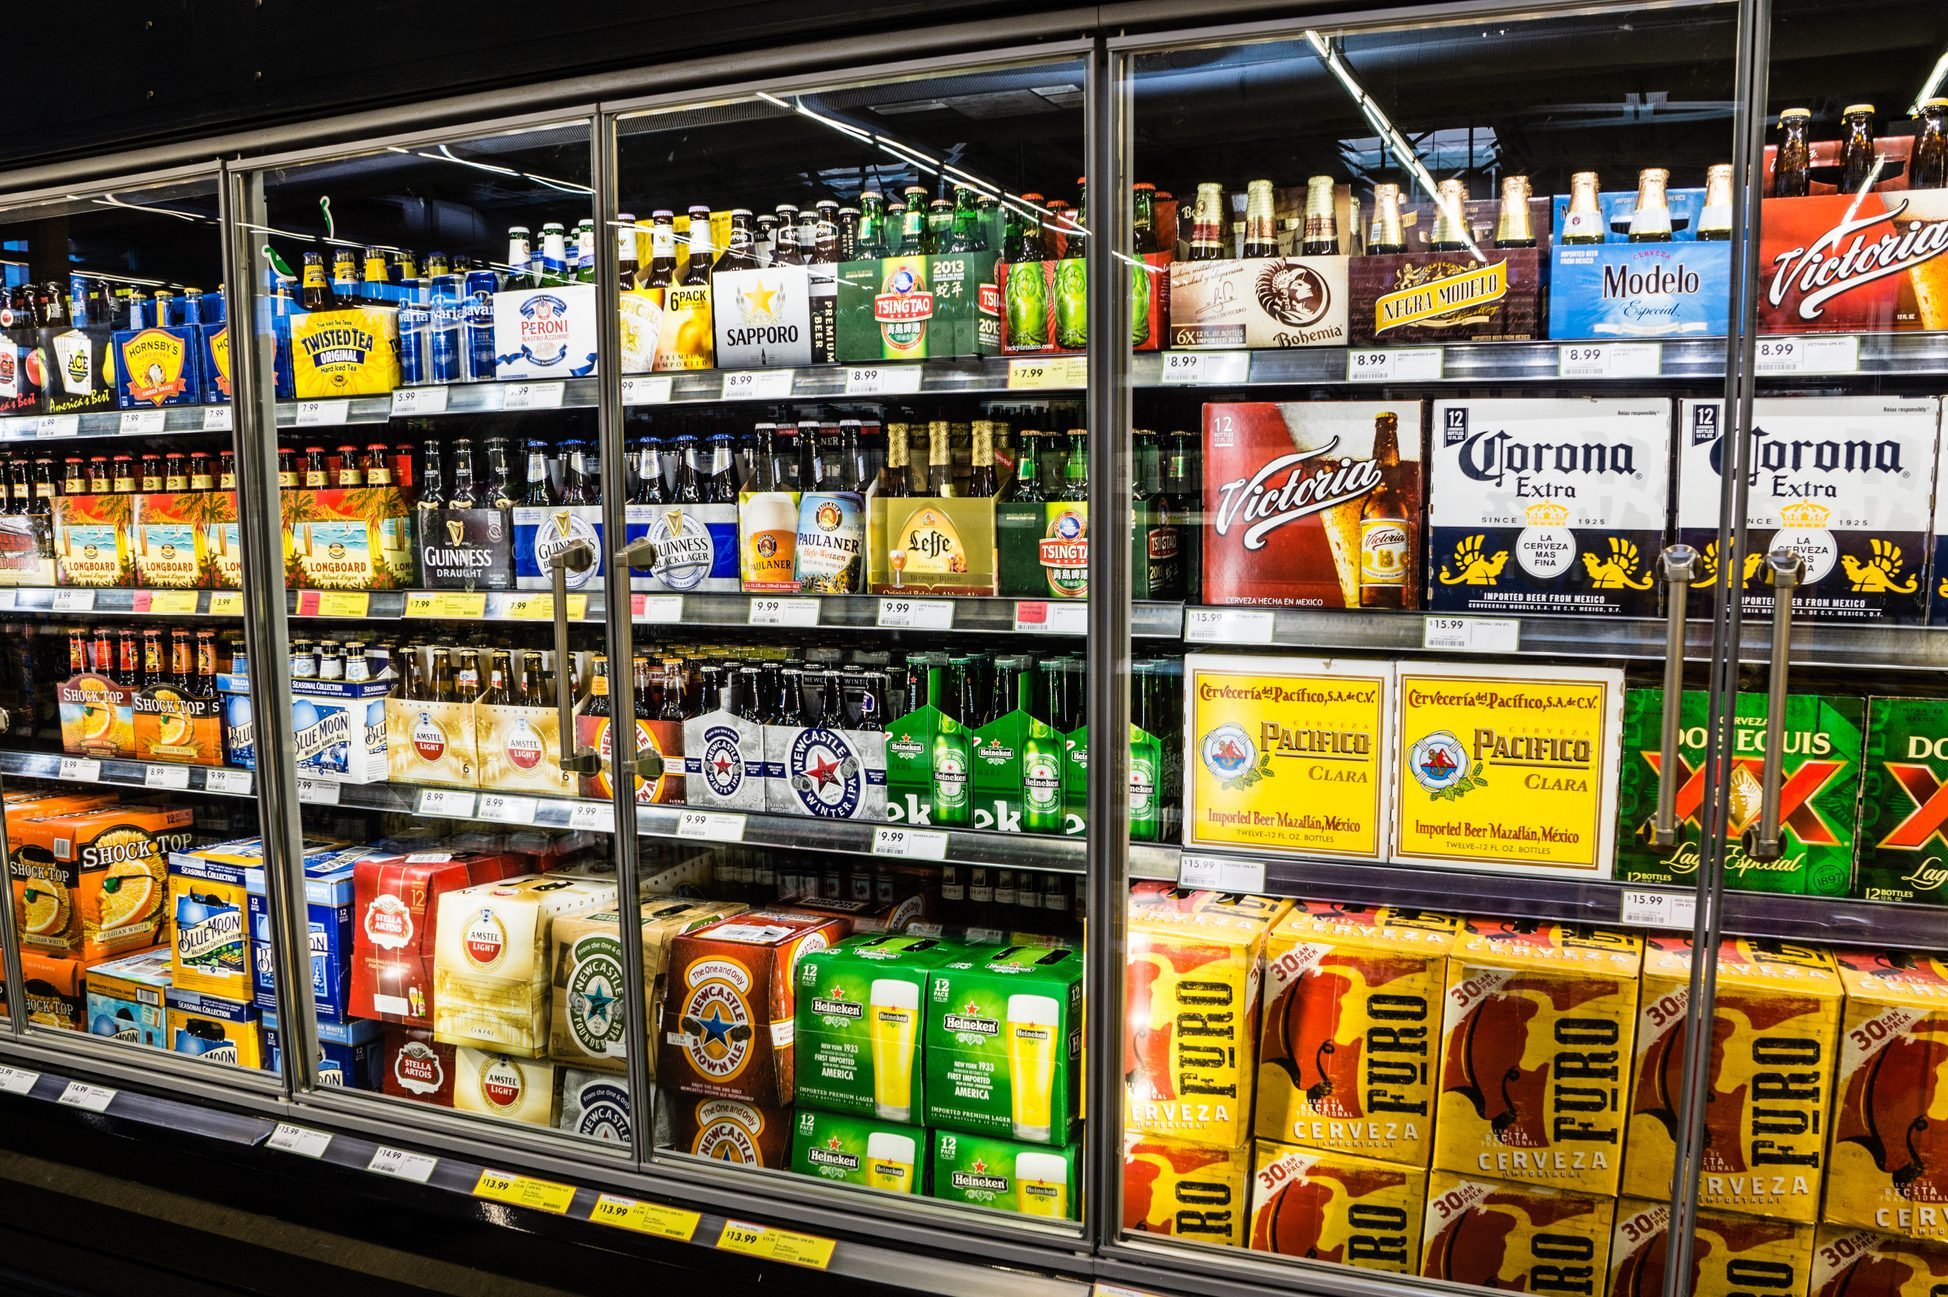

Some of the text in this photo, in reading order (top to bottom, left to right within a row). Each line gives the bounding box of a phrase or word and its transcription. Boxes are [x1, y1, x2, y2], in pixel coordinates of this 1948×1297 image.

[1633, 250, 1672, 261] CERVEZA
[1768, 198, 1948, 320] Victoria
[933, 261, 965, 274] 2013
[1603, 264, 1699, 299] Modelo
[936, 281, 963, 298] 蛇年
[1383, 272, 1498, 322] NEGRA MODELO
[670, 292, 679, 311] 6
[680, 289, 706, 302] PACK
[877, 298, 930, 314] TSINGTAO
[521, 320, 568, 335] PERONI
[814, 316, 823, 348] BEER
[824, 300, 835, 363] PREMIUM
[301, 328, 373, 355] TWISTED TEA
[522, 335, 544, 343] NASTRO
[727, 325, 799, 347] SAPPORO
[1177, 329, 1196, 345] 6X
[1228, 336, 1244, 344] BEER
[1273, 325, 1343, 347] Bohemia
[129, 340, 178, 358] HORNSBY'S
[320, 349, 358, 364] ORIGINAL
[68, 354, 89, 370] ACE
[321, 366, 333, 374] Hard
[347, 364, 357, 372] Tea
[1448, 411, 1463, 427] 12
[1697, 408, 1714, 424] 12
[1214, 416, 1232, 432] 12
[1458, 430, 1637, 487] Corona
[1215, 435, 1382, 551] Victoria
[1516, 477, 1576, 498] Extra
[1771, 475, 1837, 498] Extra
[798, 532, 859, 554] PAULANER
[908, 529, 952, 559] Leffe
[1364, 528, 1405, 549] Victoria
[424, 546, 492, 567] GUINNESS
[69, 562, 115, 572] LONGBOARD
[146, 562, 193, 572] LONGBOARD
[310, 561, 367, 574] LONGBOARD
[437, 569, 482, 578] DRAUGHT
[1226, 596, 1256, 604] CERVEZA
[1258, 597, 1283, 605] HECHA
[1295, 598, 1323, 606] MEXICO
[1484, 592, 1605, 604] IMPORTED BEER FROM MEXICO
[1805, 598, 1866, 608] FROM MEXICO
[292, 680, 342, 691] SEASONAL COLLECTION
[63, 688, 123, 703] SHOCK TOP
[134, 697, 205, 714] SHOCK TOP
[1293, 720, 1369, 730] CERVEZA
[1509, 727, 1590, 736] CERVEZA
[416, 733, 441, 741] AMSTEL
[511, 740, 538, 748] AMSTEL
[1261, 721, 1371, 754] PACIFICO
[420, 743, 439, 751] LIGHT
[794, 730, 847, 771] NEWCASTLE
[891, 743, 922, 752] Heineken
[1474, 728, 1592, 762] PACIFICO
[514, 750, 535, 758] LIGHT
[979, 749, 1012, 758] Heineken
[463, 764, 469, 773] 6
[1308, 765, 1368, 784] CLARA
[562, 772, 569, 781] 6
[934, 772, 966, 782] Heineken
[1025, 778, 1059, 788] Heineken
[1524, 774, 1588, 792] CLARA
[1208, 808, 1361, 833] Imported Beer Mazatlán, México
[1415, 820, 1579, 844] Imported Beer Mazatlán, México
[83, 833, 192, 868] SHOCK TOP
[10, 861, 69, 882] SHOCK TOP
[181, 867, 206, 877] SEASONAL
[207, 869, 237, 883] COLLECTION
[1627, 872, 1672, 882] 12 BOTTLES
[375, 912, 402, 925] STELLA
[99, 924, 150, 940] BELGIAN WHITE
[179, 915, 240, 953] BLUE MOON
[375, 922, 402, 934] ARTOIS
[470, 931, 499, 943] AMSTEL
[191, 934, 242, 956] VALENCIA GROVE AMBER
[473, 942, 495, 953] LIGHT
[1270, 954, 1300, 983] 30
[1476, 973, 1492, 987] CAN
[1450, 981, 1480, 1008] 30
[1175, 980, 1236, 1100] FURO
[843, 1044, 859, 1053] 1933
[1367, 994, 1428, 1116] FURO
[405, 1059, 431, 1071] STELLA
[815, 1054, 855, 1065] FIRST IMPORTED
[978, 1062, 994, 1071] 1933
[404, 1068, 432, 1080] ARTOIS
[489, 1073, 517, 1086] AMSTEL
[822, 1068, 854, 1080] AMERICA
[948, 1073, 990, 1084] FIRST IMPORTED
[1554, 1018, 1619, 1145] FURO
[491, 1085, 513, 1096] LIGHT
[583, 1093, 597, 1102] From
[799, 1087, 874, 1103] IMPORTED PREMIUM LAGER
[955, 1087, 989, 1100] AMERICA
[1301, 1104, 1343, 1112] RECETA
[1752, 1037, 1821, 1169] FURO
[931, 1107, 1011, 1123] IMPORTED PREMIUM LAGER
[1258, 1163, 1284, 1190] 30
[482, 1179, 509, 1191] $13.99
[600, 1204, 628, 1217] $13.99
[726, 1231, 757, 1245] $13.99
